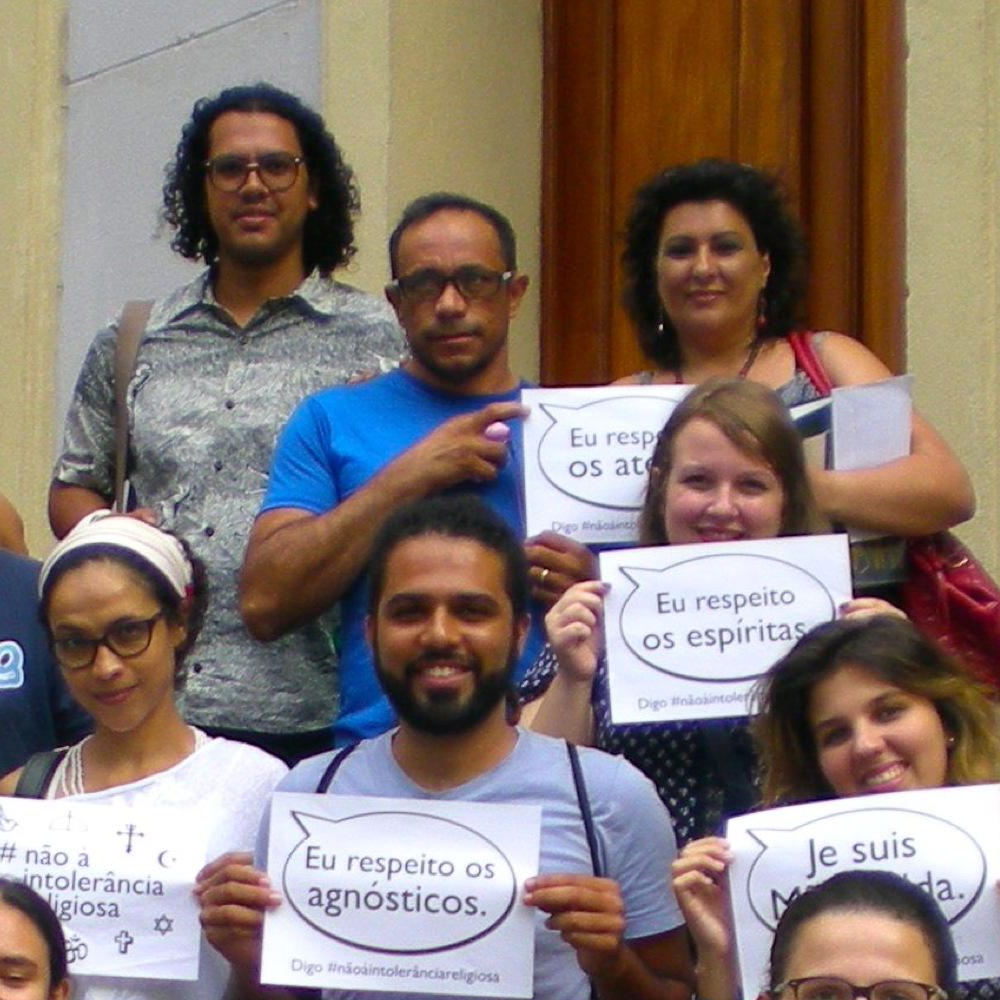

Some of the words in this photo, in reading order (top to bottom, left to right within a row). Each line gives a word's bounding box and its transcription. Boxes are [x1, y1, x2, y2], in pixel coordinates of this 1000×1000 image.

[570, 427, 597, 448] Eu
[606, 430, 658, 451] resp
[569, 459, 603, 478] os
[551, 520, 579, 536] Digo
[656, 591, 686, 614] Eu
[696, 586, 795, 616] respeito
[642, 632, 676, 651] os
[637, 696, 668, 712] Digo
[0, 842, 17, 864] #
[25, 844, 69, 867] não
[305, 846, 336, 871] Eu
[347, 852, 455, 881] respeito
[465, 861, 496, 880] os
[806, 837, 838, 879] Je
[852, 831, 917, 865] suis
[47, 892, 121, 922] ligiosa
[307, 880, 487, 917] agnósticos.
[291, 958, 323, 977] Digo
